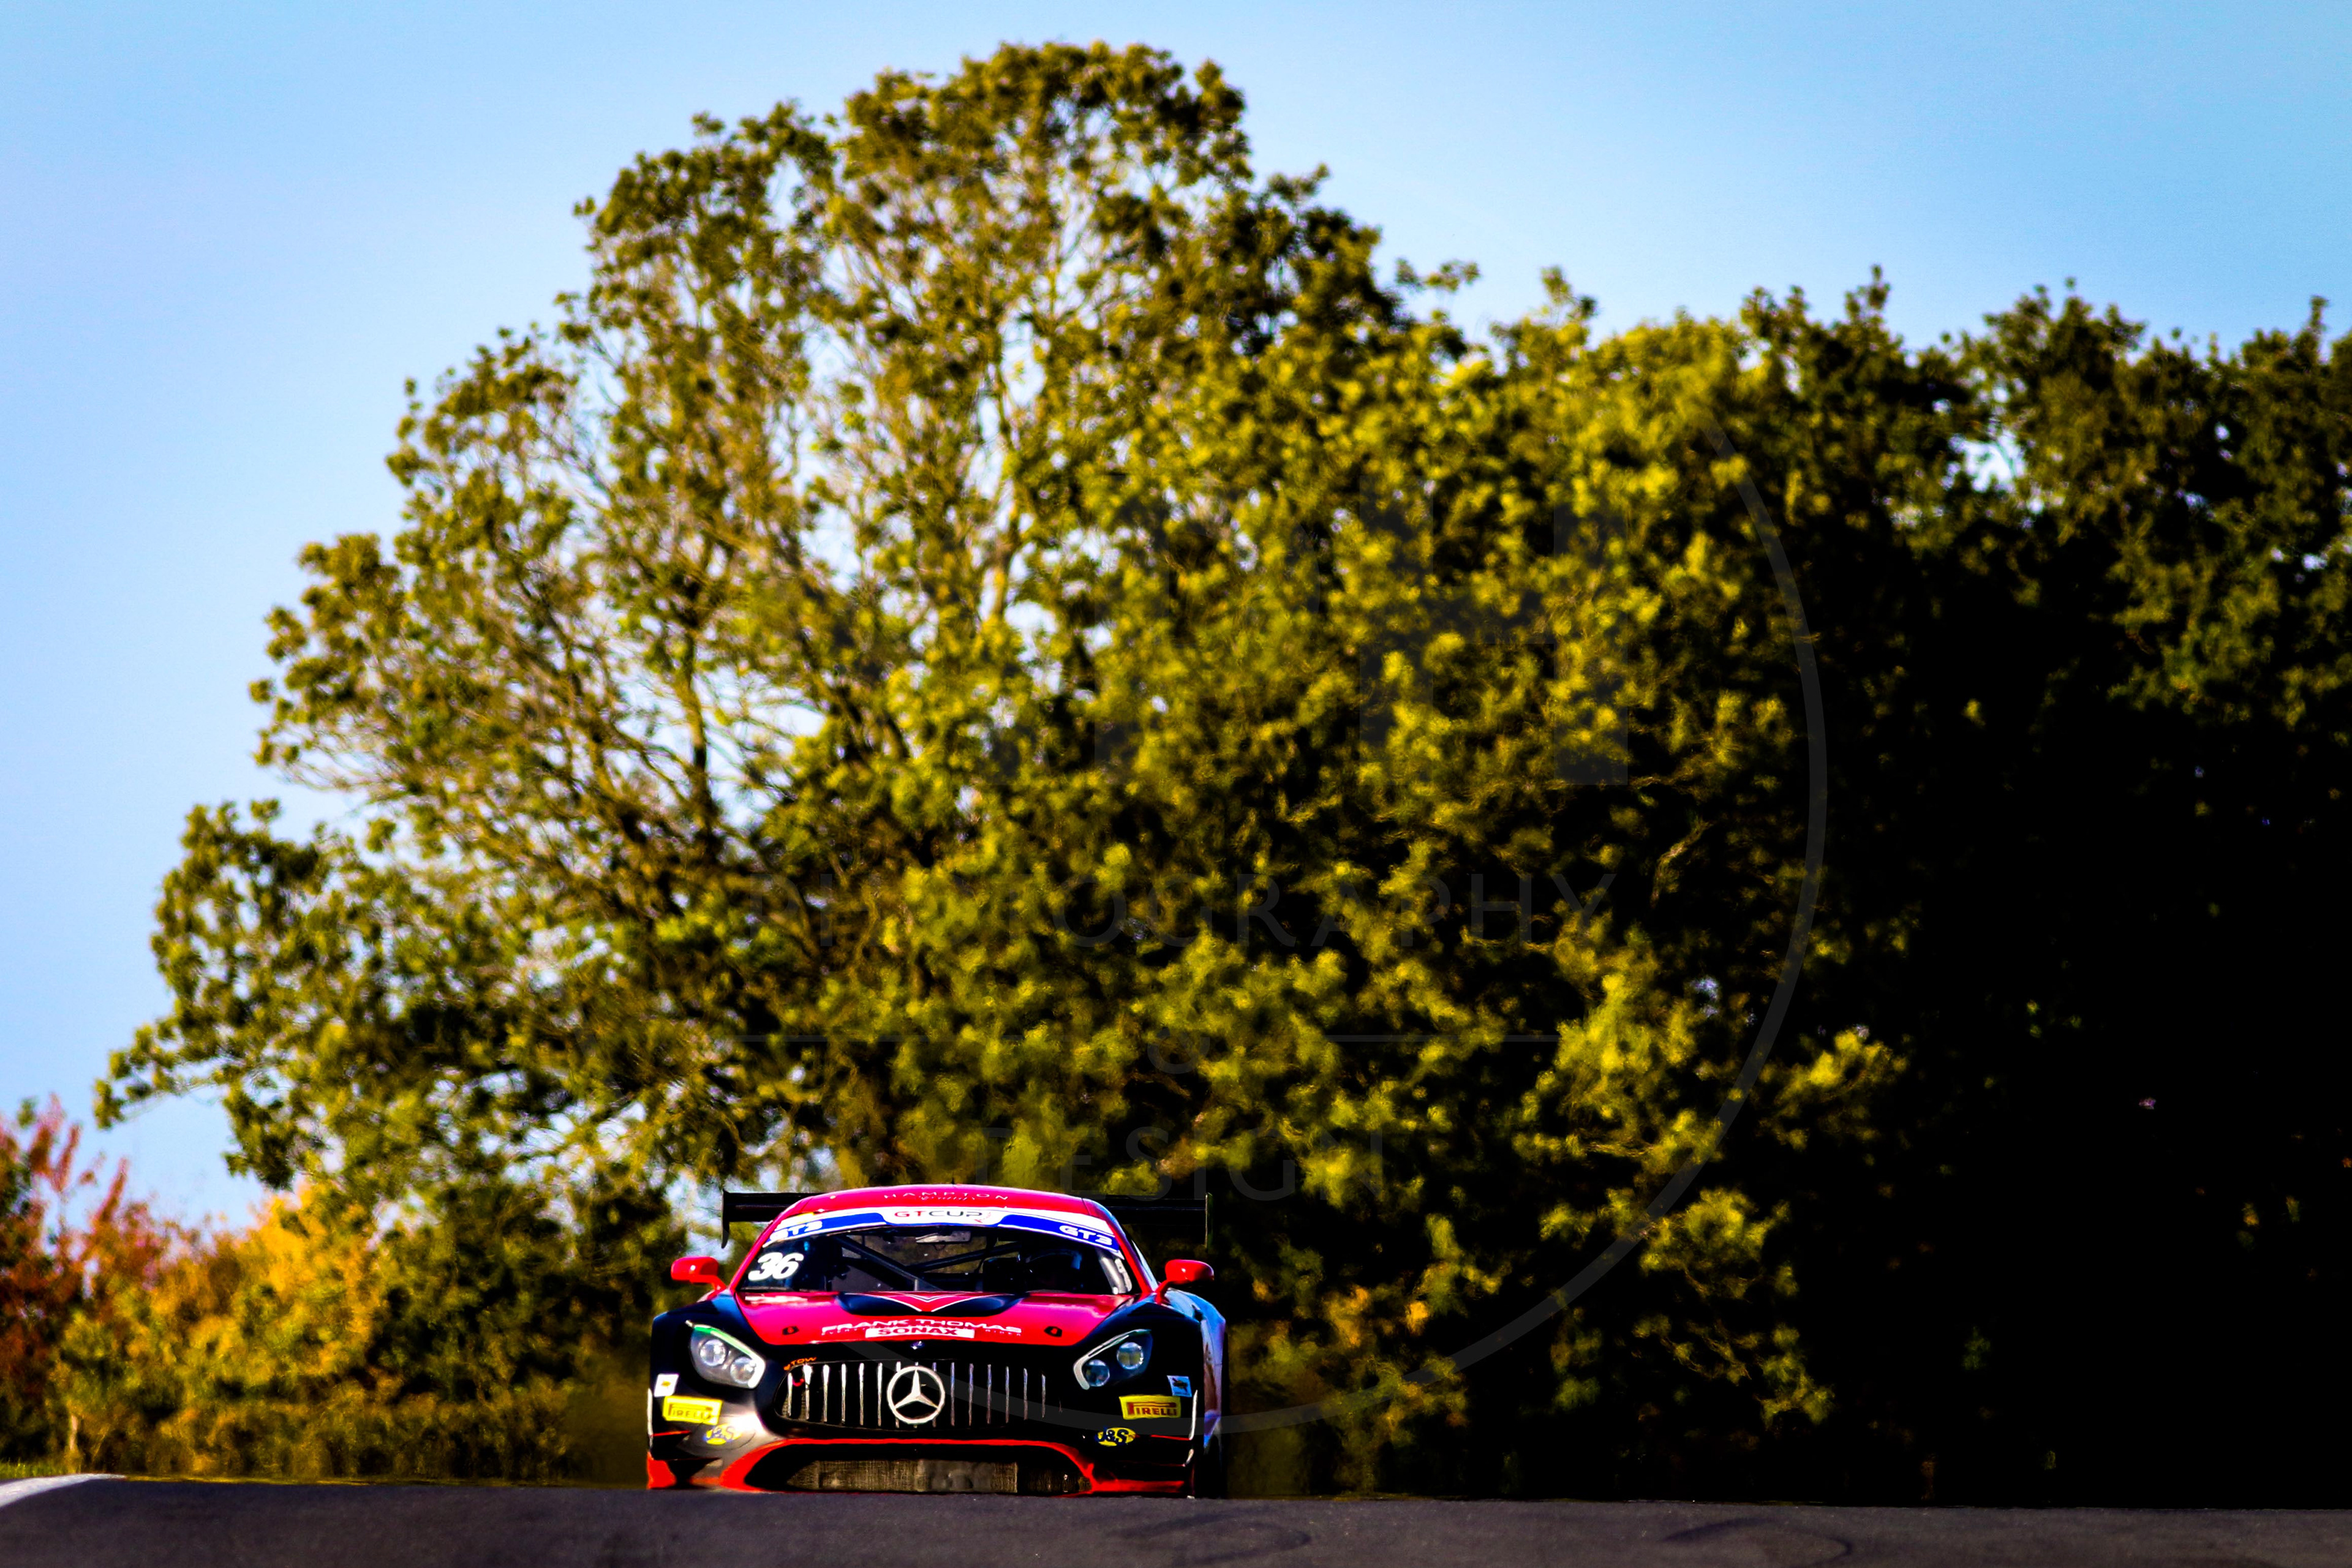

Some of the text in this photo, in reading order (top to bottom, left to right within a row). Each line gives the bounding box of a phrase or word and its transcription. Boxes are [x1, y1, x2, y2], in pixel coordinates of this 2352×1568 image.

[884, 1191, 1008, 1200] HAMPTON
[1059, 1225, 1112, 1246] GT3
[748, 1251, 804, 1281] 36
[821, 1319, 910, 1335] FRANK
[915, 1319, 1022, 1333] THOMAS
[878, 1327, 959, 1335] SONAX
[790, 1356, 817, 1366] TOW
[1126, 1401, 1177, 1416] PIRELLI
